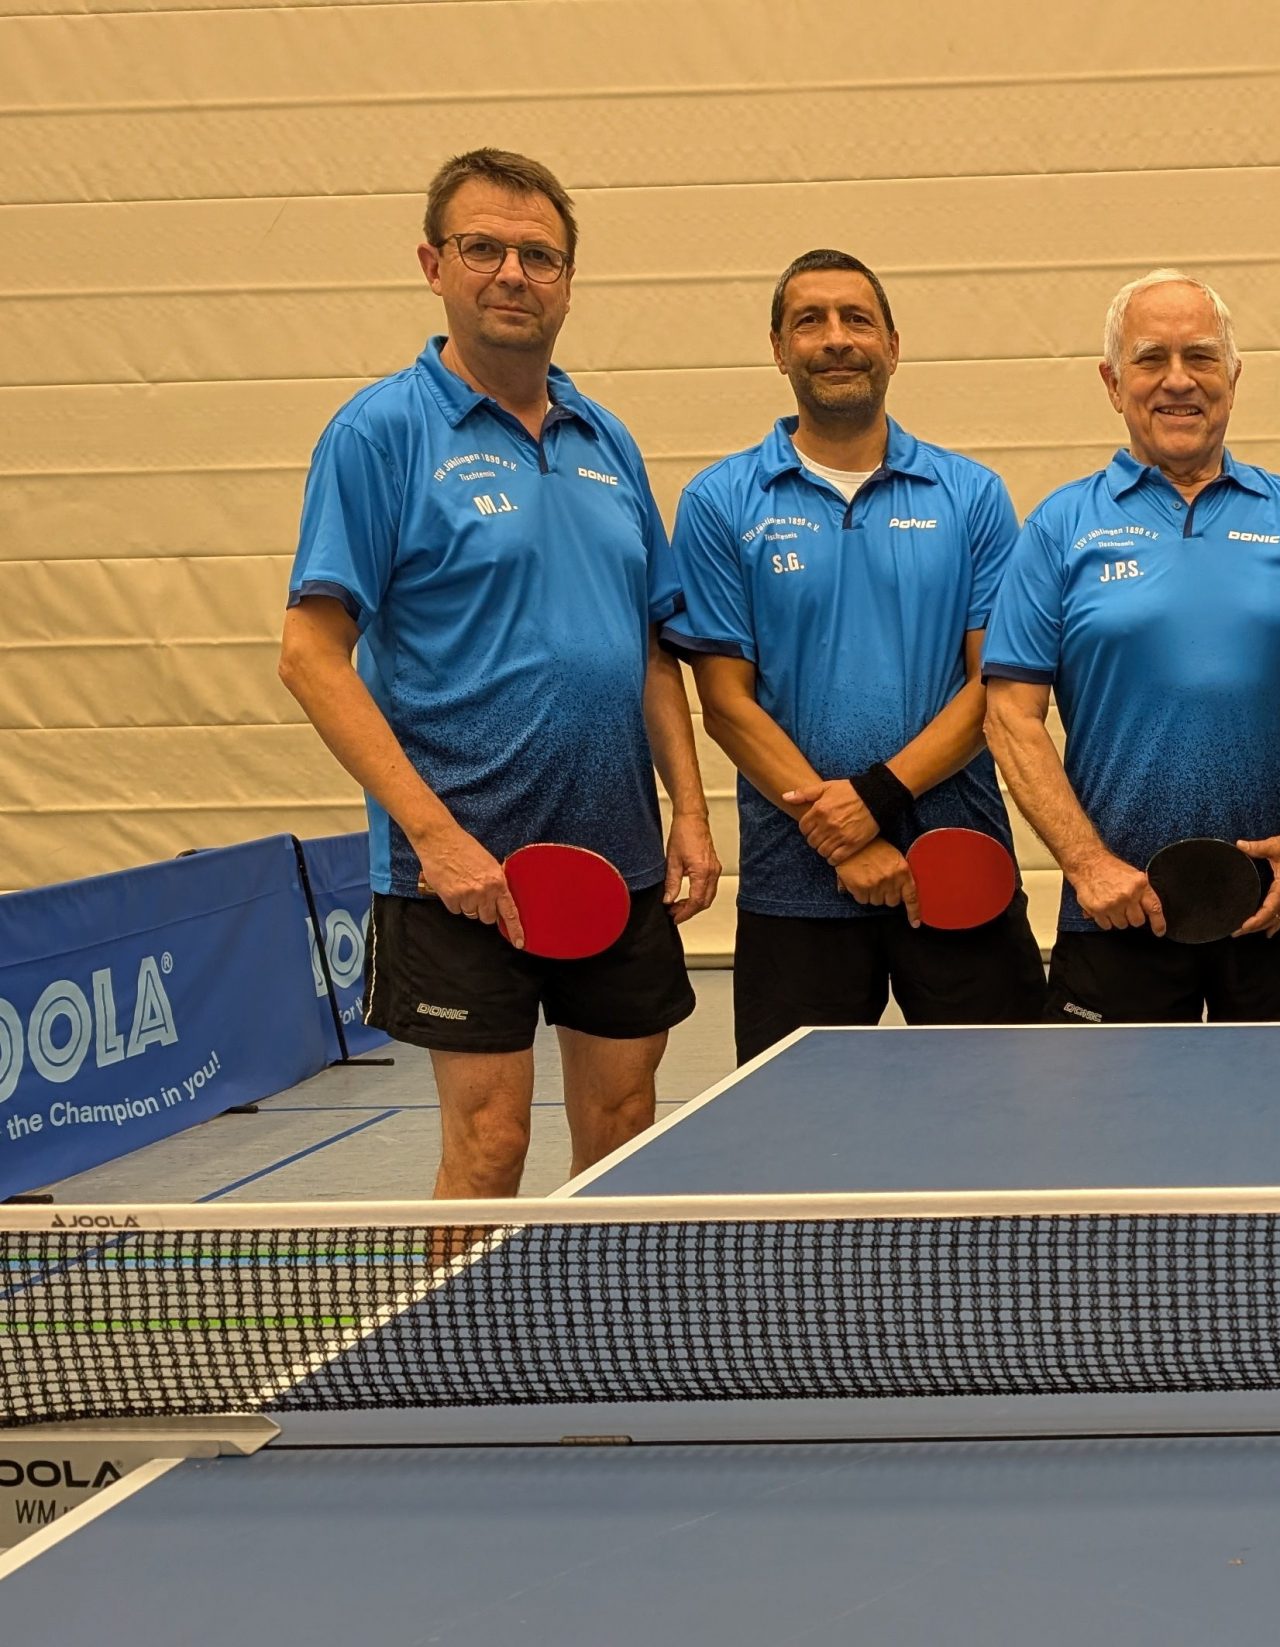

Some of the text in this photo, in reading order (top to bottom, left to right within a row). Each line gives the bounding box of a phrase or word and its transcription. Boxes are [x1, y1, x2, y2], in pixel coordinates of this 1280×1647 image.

[577, 467, 619, 486] DONIC
[473, 493, 519, 516] M.J.
[889, 517, 937, 529] DONIC
[742, 529, 755, 543] TSV
[1074, 537, 1088, 550] TSV
[1228, 530, 1280, 544] DONIC
[772, 552, 805, 574] S.G.
[1100, 560, 1144, 582] J.P.S.
[417, 1002, 469, 1021] DONIC
[7, 1051, 222, 1140] the Champion in you!
[68, 1215, 140, 1228] JOOLA
[15, 1499, 57, 1524] WM
